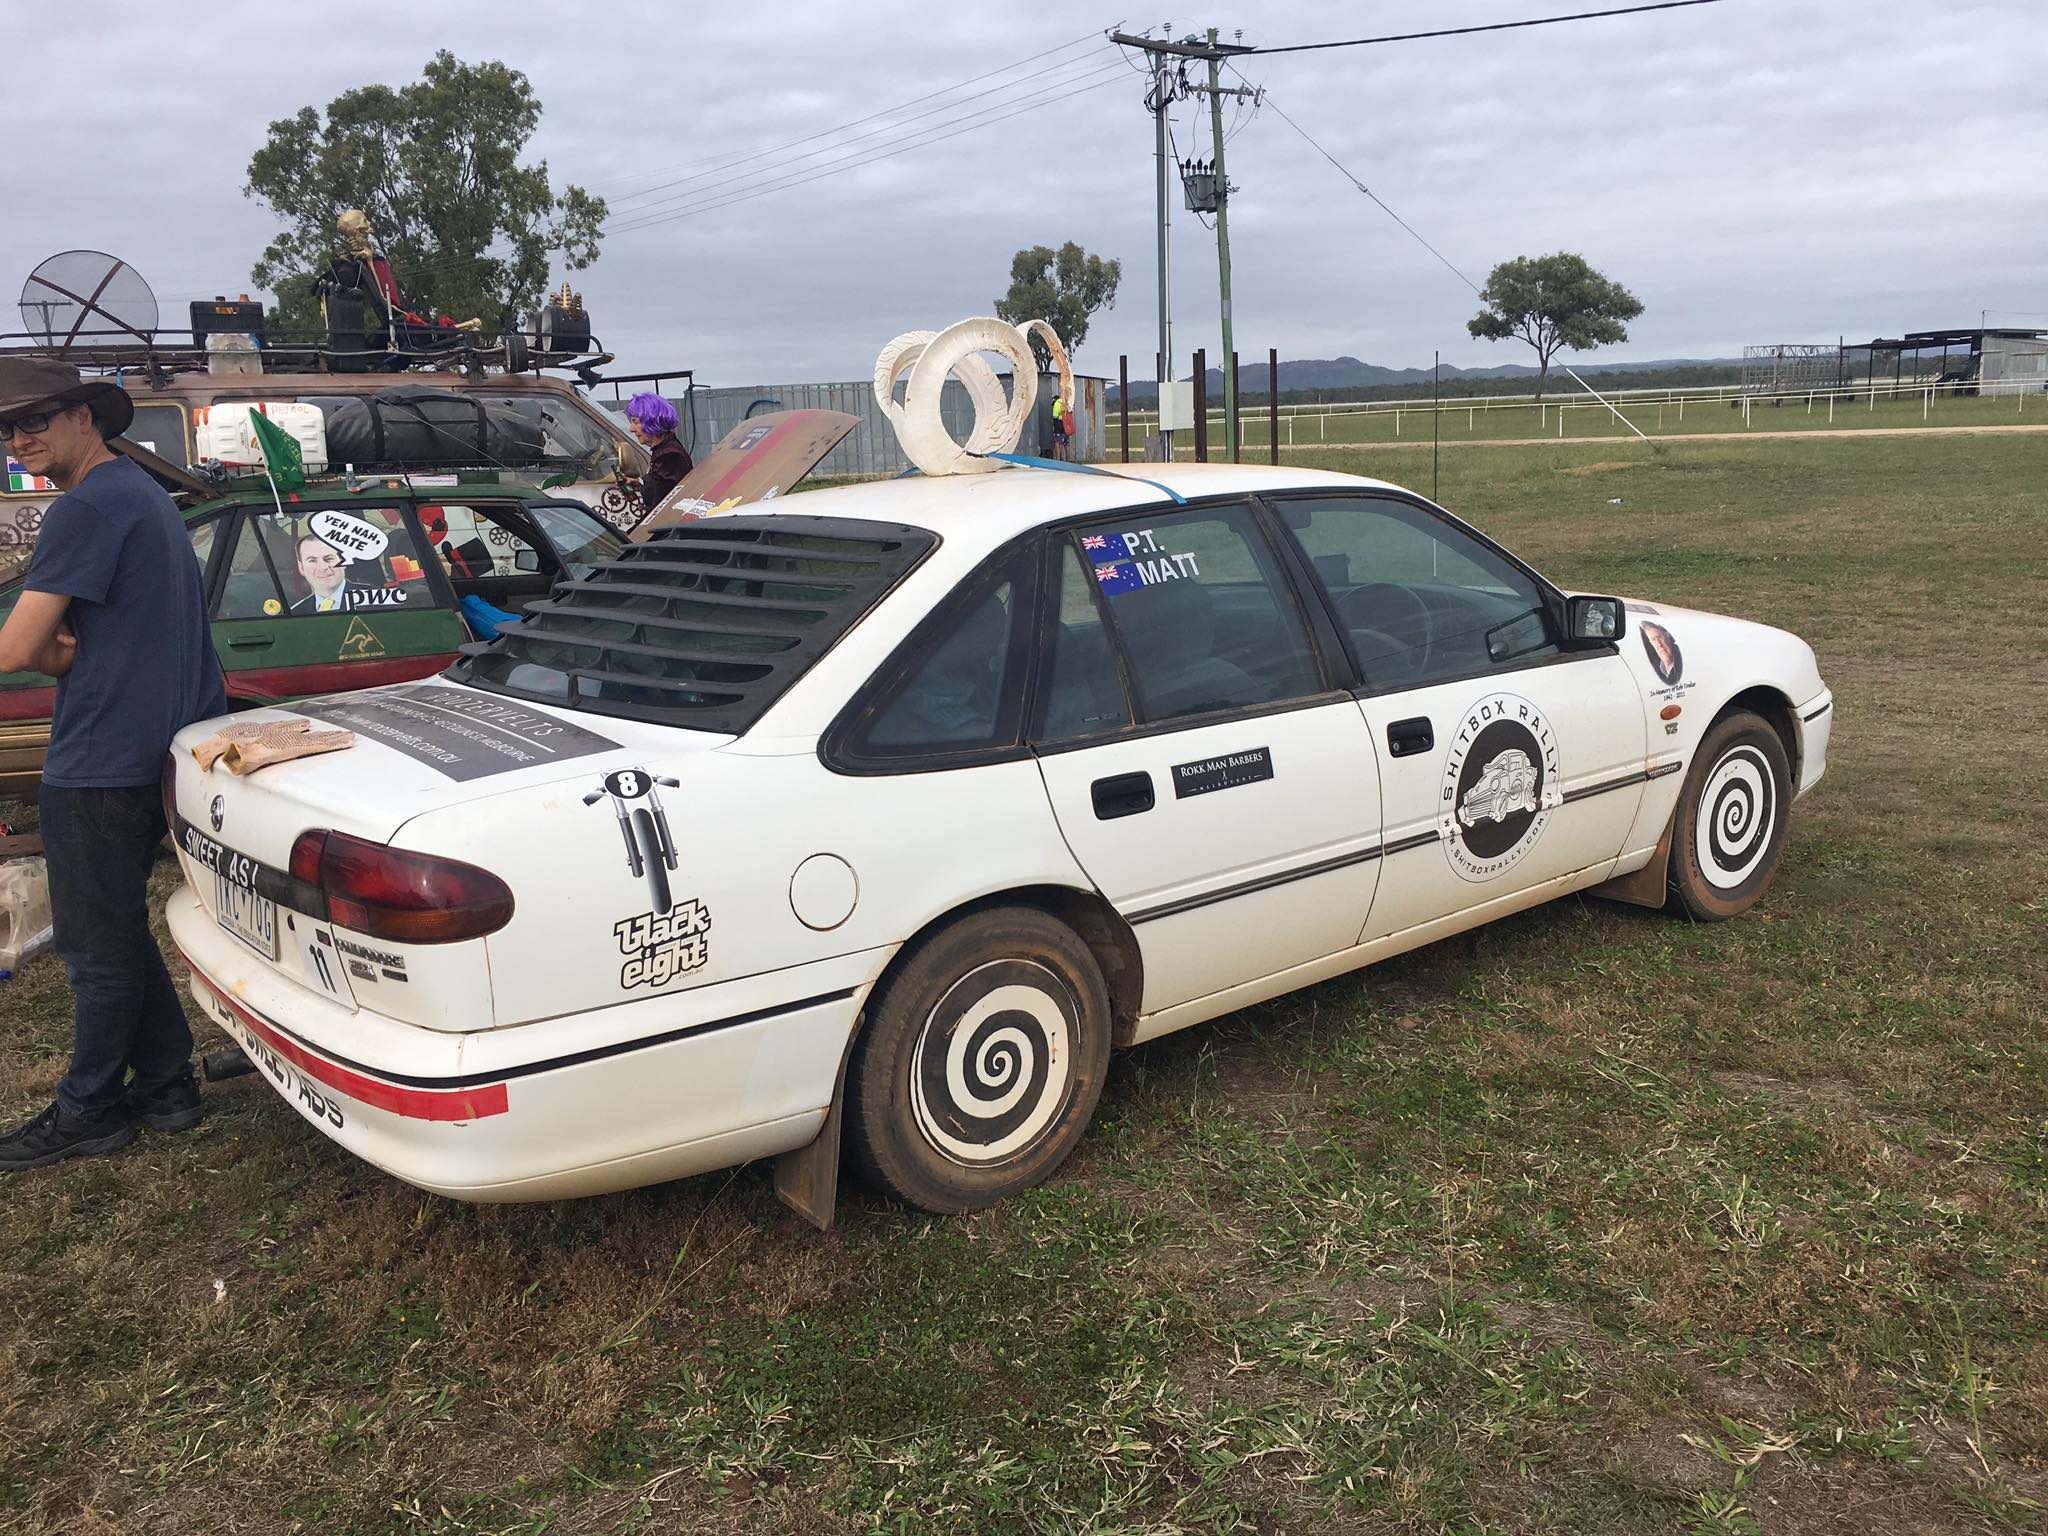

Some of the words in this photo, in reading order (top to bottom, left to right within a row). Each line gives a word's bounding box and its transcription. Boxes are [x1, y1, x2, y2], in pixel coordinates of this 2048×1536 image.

[323, 529, 368, 552] MATE
[324, 514, 350, 530] YEH
[350, 525, 381, 545] NAH,
[1121, 529, 1165, 556] P.T.
[1135, 552, 1200, 586] MATT
[344, 587, 407, 612] pwc
[1180, 764, 1206, 777] ROKK
[1207, 760, 1227, 772] MAN
[1228, 752, 1264, 767] BARBERS
[1443, 700, 1506, 802] SHITBOX
[617, 771, 640, 798] 8
[185, 827, 224, 875] SWEET
[613, 898, 711, 955] black
[308, 944, 337, 994] 11
[621, 935, 708, 989] eight
